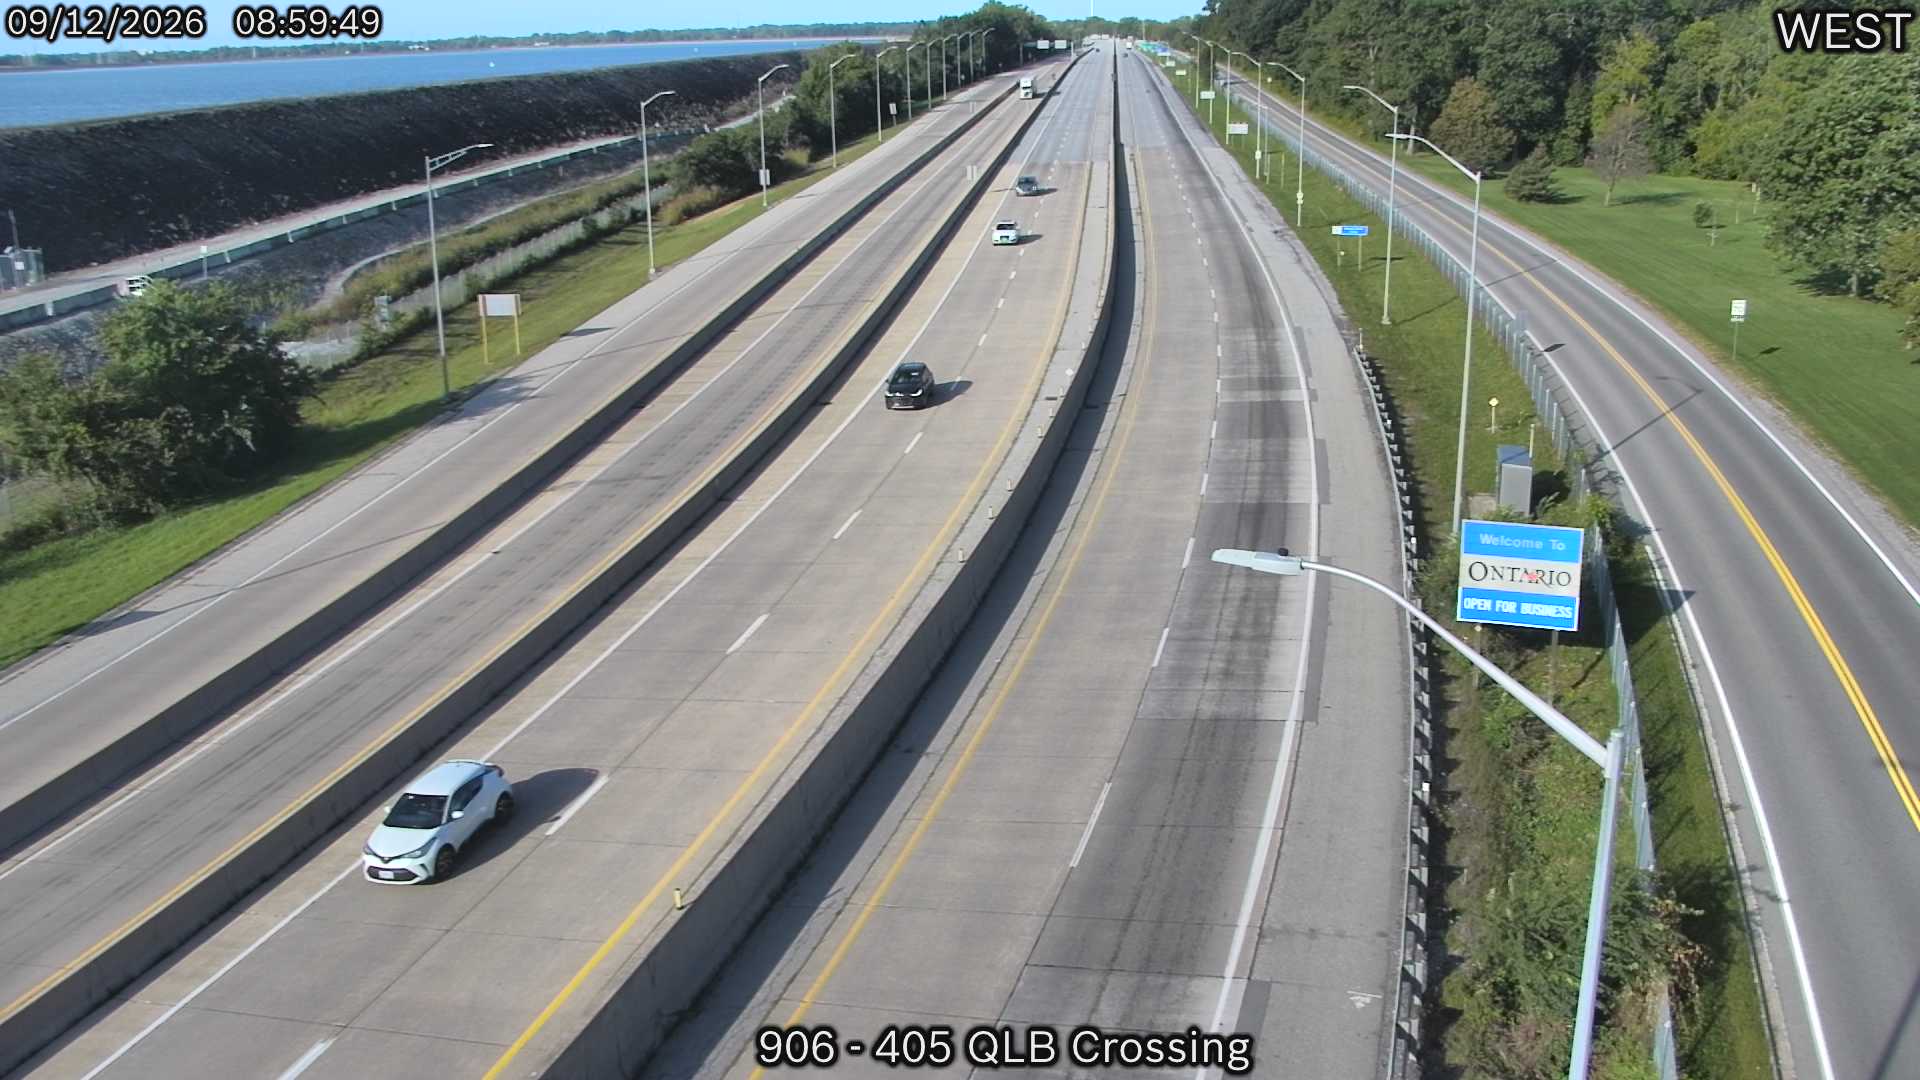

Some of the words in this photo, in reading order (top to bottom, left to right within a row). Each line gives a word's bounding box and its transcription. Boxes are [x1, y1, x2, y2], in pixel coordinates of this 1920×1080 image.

[1479, 533, 1544, 549] Welcome
[1550, 539, 1566, 551] To
[1463, 597, 1492, 612] OPEN
[1495, 600, 1517, 614] FOR
[1520, 602, 1573, 619] BUSINESS
